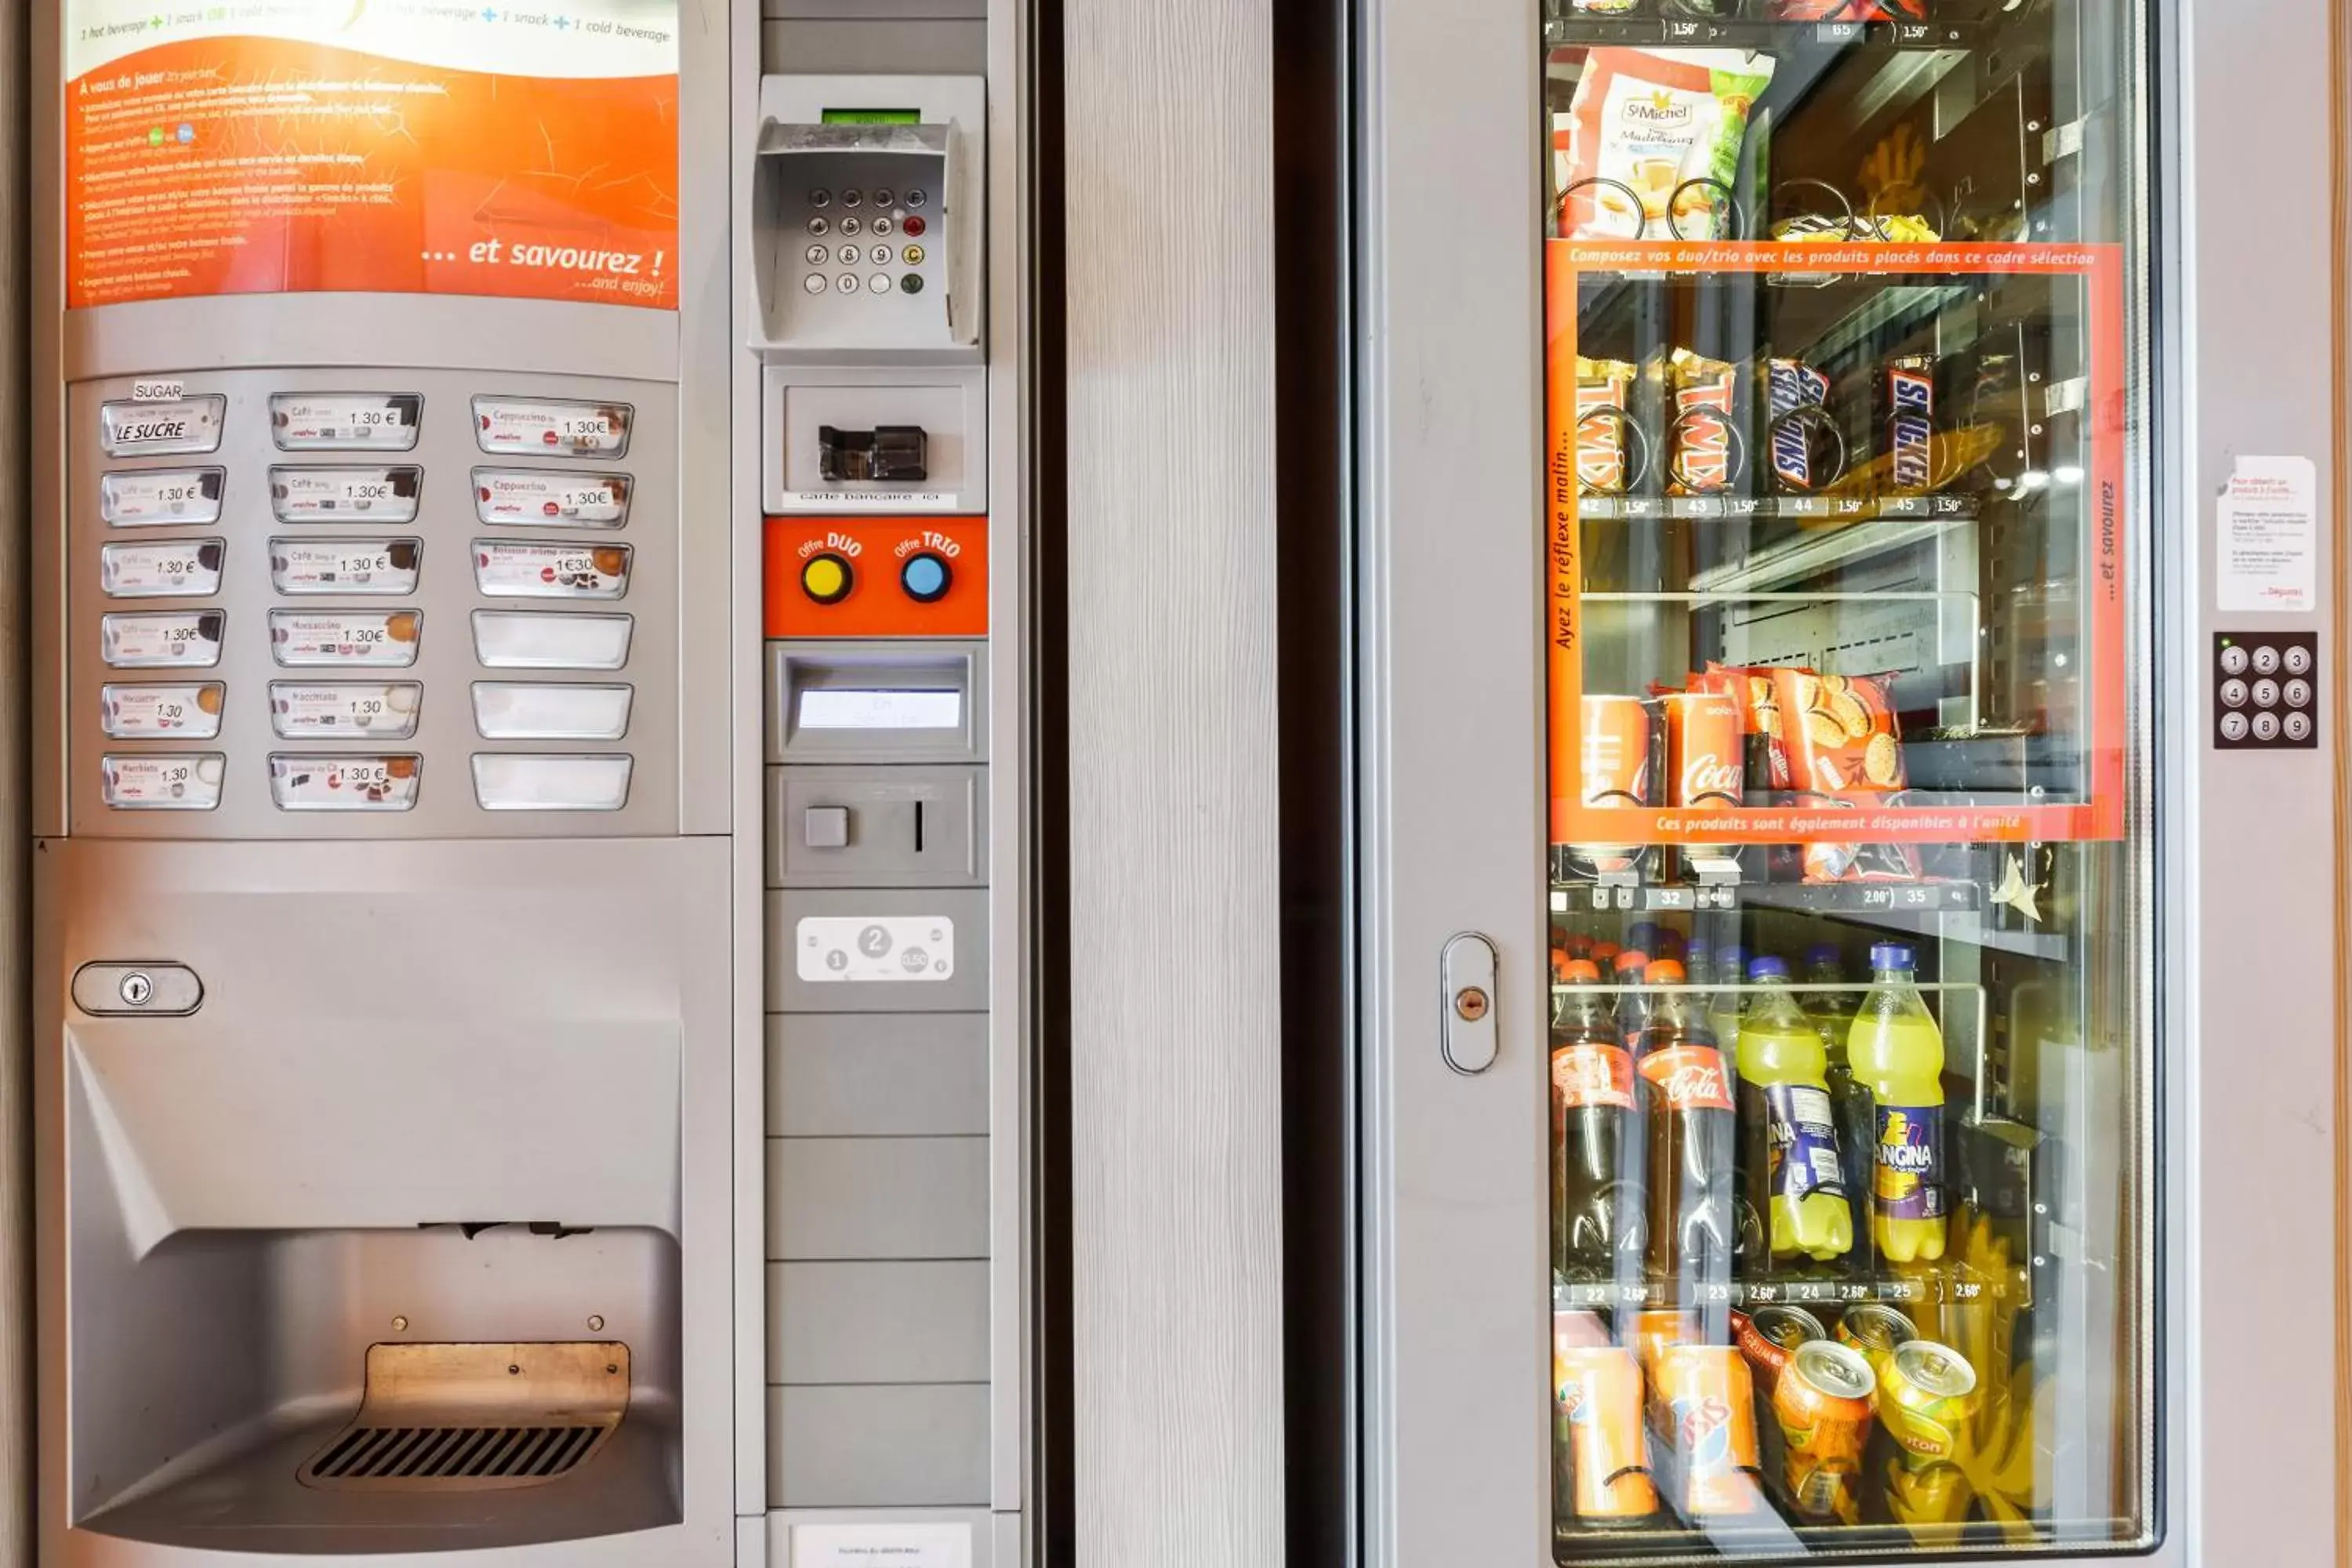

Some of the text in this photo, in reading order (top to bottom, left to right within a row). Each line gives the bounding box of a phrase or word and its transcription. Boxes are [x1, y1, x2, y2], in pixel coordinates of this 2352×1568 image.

[89, 26, 105, 38] hot
[107, 20, 147, 38] beverage
[514, 11, 548, 27] snack
[586, 21, 612, 34] cold
[615, 24, 670, 43] beverage
[90, 80, 114, 93] vous
[118, 75, 132, 89] de
[135, 72, 164, 90] jouer
[847, 219, 855, 231] 5
[879, 220, 887, 231] 6
[470, 238, 503, 263] et
[510, 241, 643, 274] savourez
[812, 249, 919, 261] 7 8 9 C
[1570, 247, 2095, 266] Composez vos duo/trio avec les produits placés dans ce cadre sélection
[622, 278, 664, 296] enjoy!
[844, 277, 852, 289] 0
[135, 385, 183, 397] SUGAR
[351, 412, 396, 424] 1.30 €
[118, 421, 185, 440] LE SUCRE
[564, 420, 607, 434] 1.30€
[158, 488, 183, 500] 1.30
[187, 487, 196, 499] €
[347, 485, 387, 499] 1.30€
[565, 491, 608, 505] 1.30€
[1688, 499, 1707, 511] 43
[1794, 499, 1812, 511] 44
[1896, 499, 1915, 510] 45
[2101, 480, 2114, 555] savourez
[797, 531, 863, 559] Offre DUO
[894, 530, 961, 558] Offre TRIO
[1553, 511, 1574, 575] réflexe
[158, 560, 196, 573] 1.30 €
[341, 556, 386, 572] 1.30 €
[1555, 582, 1571, 599] le
[164, 628, 198, 641] 1.30€
[1556, 606, 1576, 650] Ayez
[345, 630, 385, 642] 1.30€
[2231, 655, 2302, 666] 1 2 3
[2230, 688, 2301, 699] 4 5 6
[158, 703, 183, 718] 1.30
[351, 701, 382, 713] 1.30
[2230, 720, 2302, 732] 7 8 9
[162, 768, 188, 782] 1.30
[339, 768, 369, 781] 1.30
[375, 768, 385, 781] €
[1656, 815, 2020, 834] Ces produits sont également disponibles à l'unité
[1661, 891, 1682, 905] 32
[1907, 891, 1926, 902] 35
[868, 928, 882, 951] 2
[832, 952, 841, 967] 1
[1586, 1288, 1605, 1301] 22
[1709, 1286, 1727, 1299] 23
[1801, 1286, 1820, 1298] 24
[1893, 1285, 1911, 1298] 25
